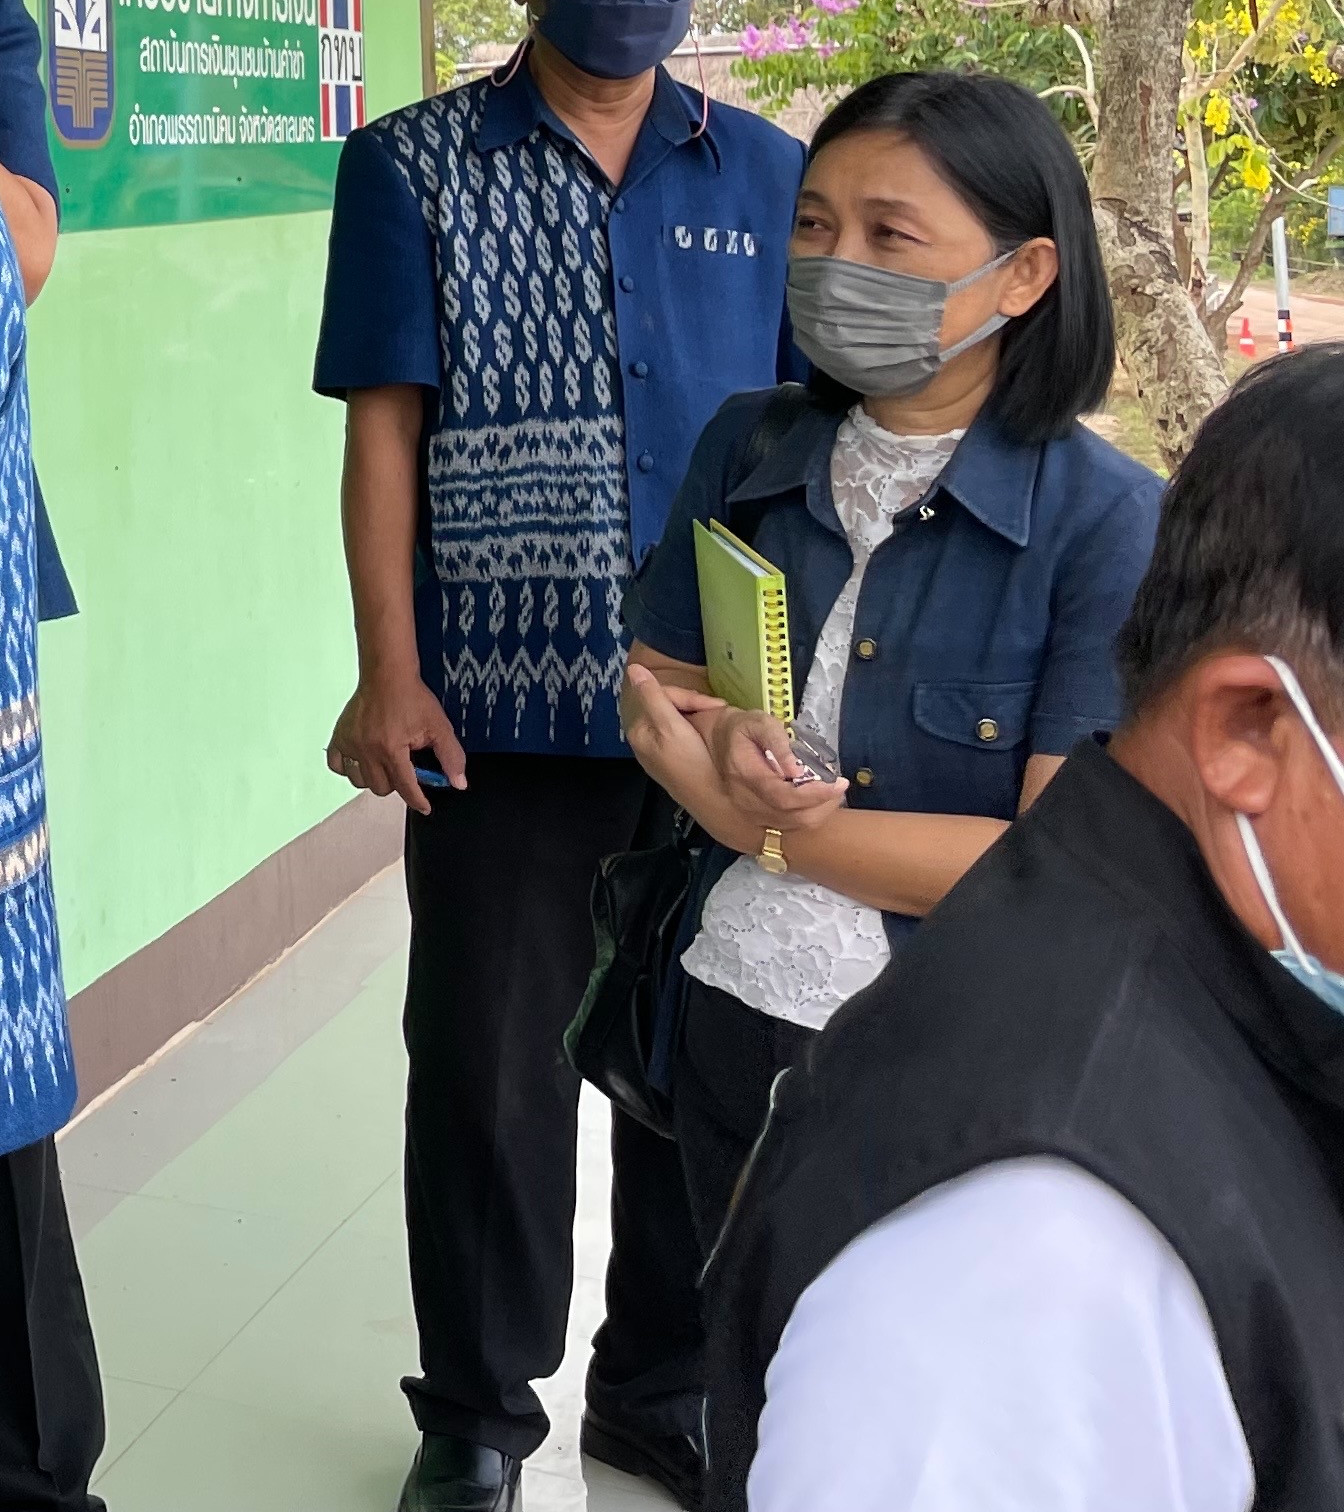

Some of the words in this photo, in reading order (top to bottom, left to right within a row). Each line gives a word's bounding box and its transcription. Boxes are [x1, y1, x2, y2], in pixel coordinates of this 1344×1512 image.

[238, 105, 315, 144] จังหวัดสกลนคร
